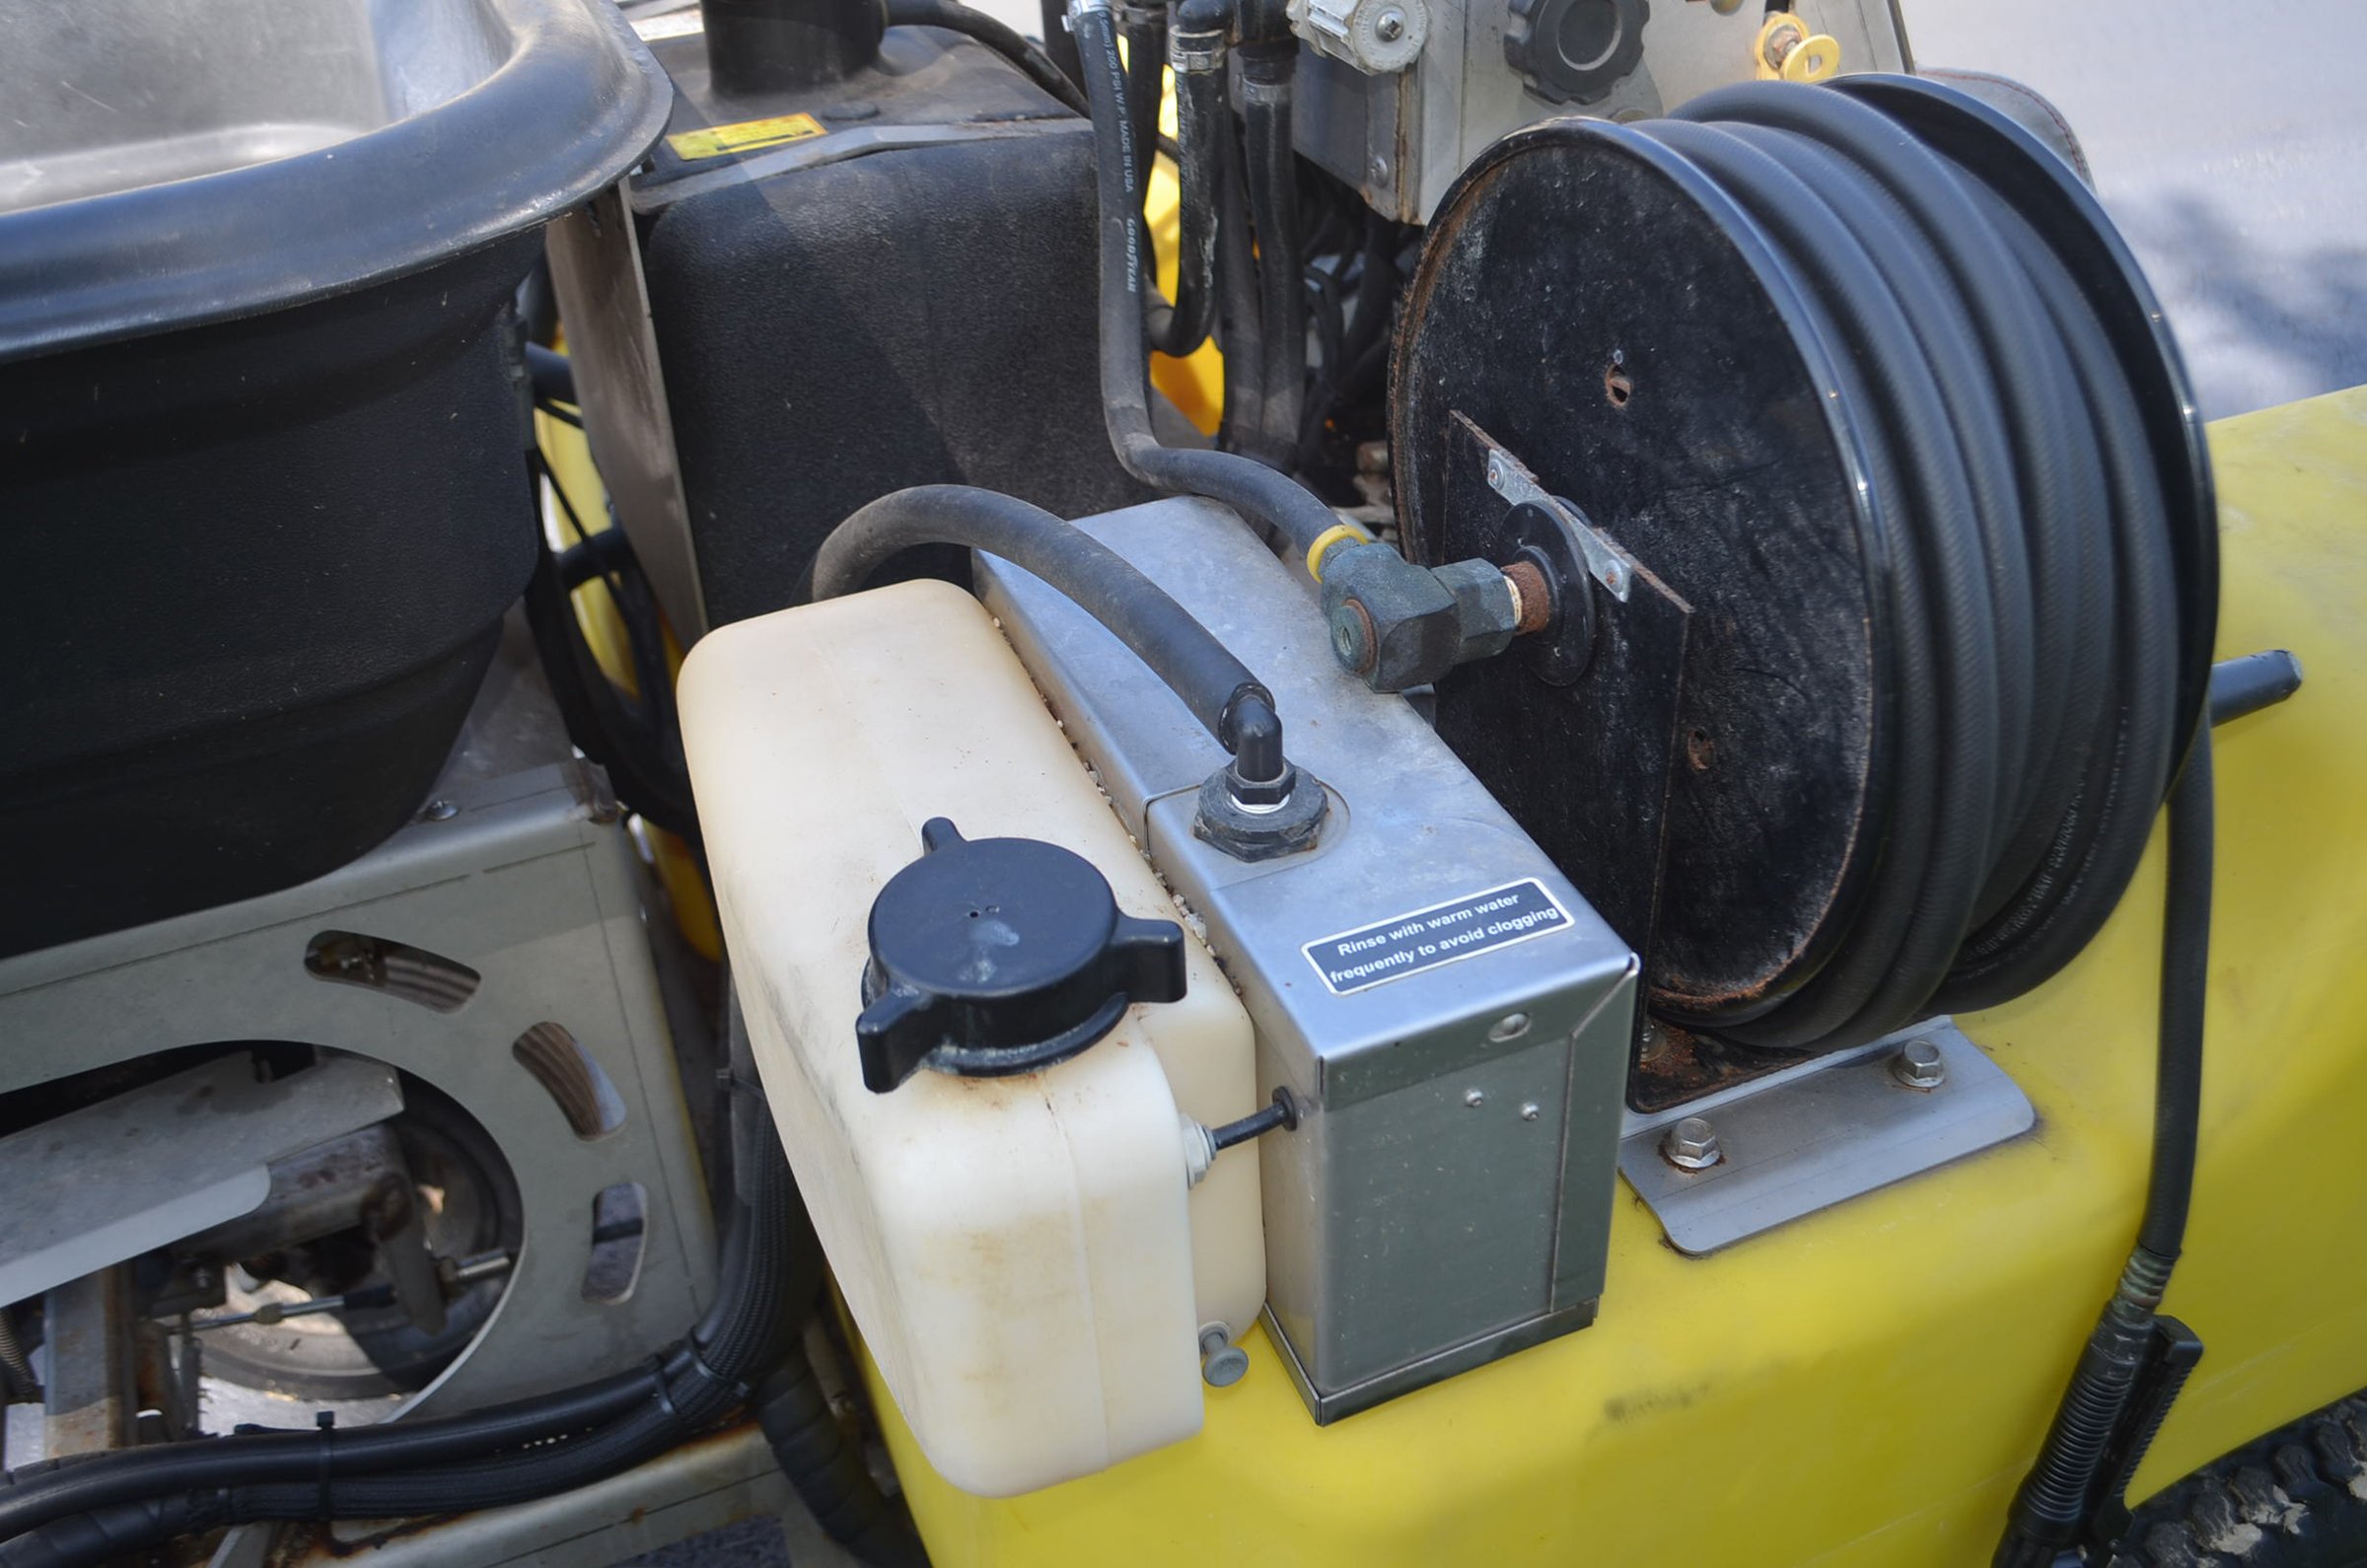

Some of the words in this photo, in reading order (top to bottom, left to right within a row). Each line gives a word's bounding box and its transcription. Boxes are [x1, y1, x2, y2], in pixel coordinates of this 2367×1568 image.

[1110, 72, 1120, 91] PSI
[1118, 120, 1131, 153] MADE
[1122, 155, 1132, 167] IN
[1123, 169, 1134, 192] USA
[1125, 217, 1138, 293] GOODYEAR
[1337, 932, 1387, 957] Rinse
[1389, 920, 1425, 942] with
[1427, 907, 1473, 929] warm
[1474, 893, 1519, 915] water
[1330, 949, 1415, 984] frequently
[1417, 941, 1437, 957] to
[1439, 927, 1485, 951] avoid
[1487, 905, 1559, 937] clogging
